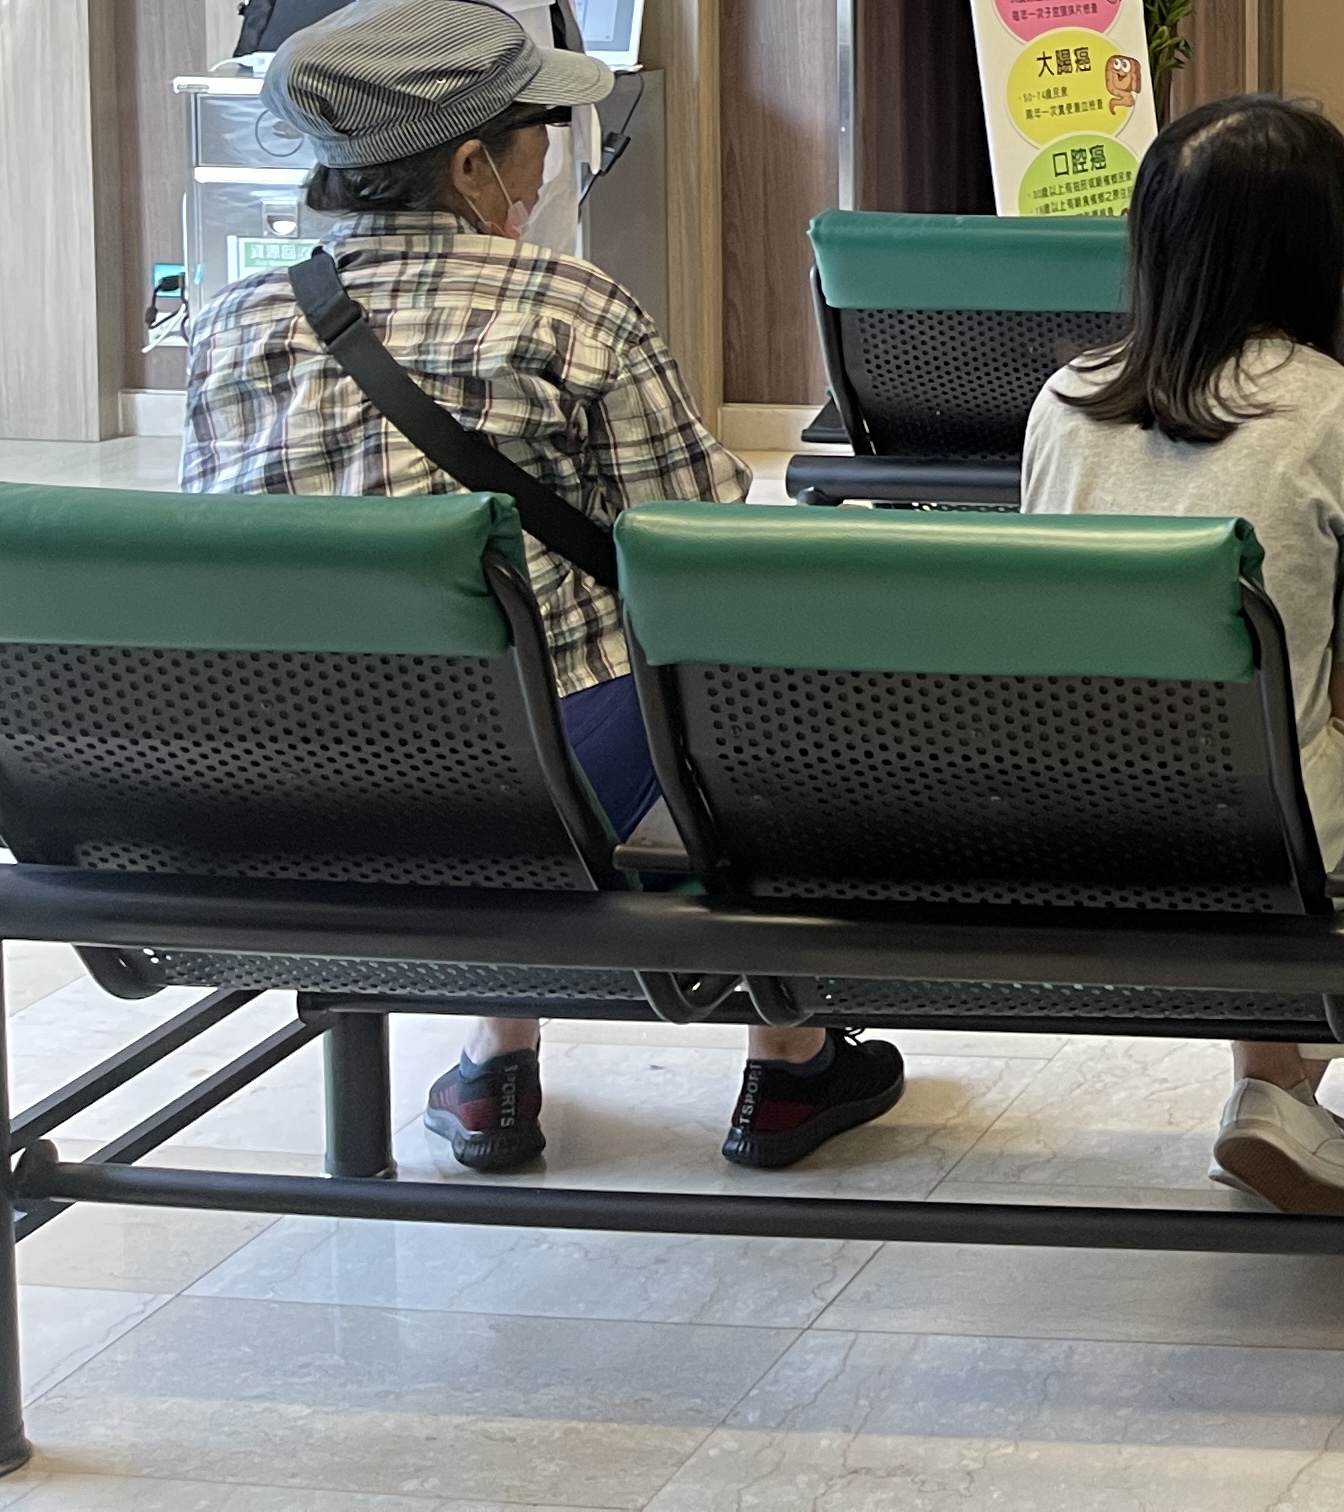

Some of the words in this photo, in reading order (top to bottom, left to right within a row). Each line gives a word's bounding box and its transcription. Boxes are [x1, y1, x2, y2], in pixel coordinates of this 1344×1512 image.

[1036, 46, 1092, 78] 大腸癌
[1052, 144, 1107, 178] 口腔癌
[500, 1064, 518, 1128] SPORTS
